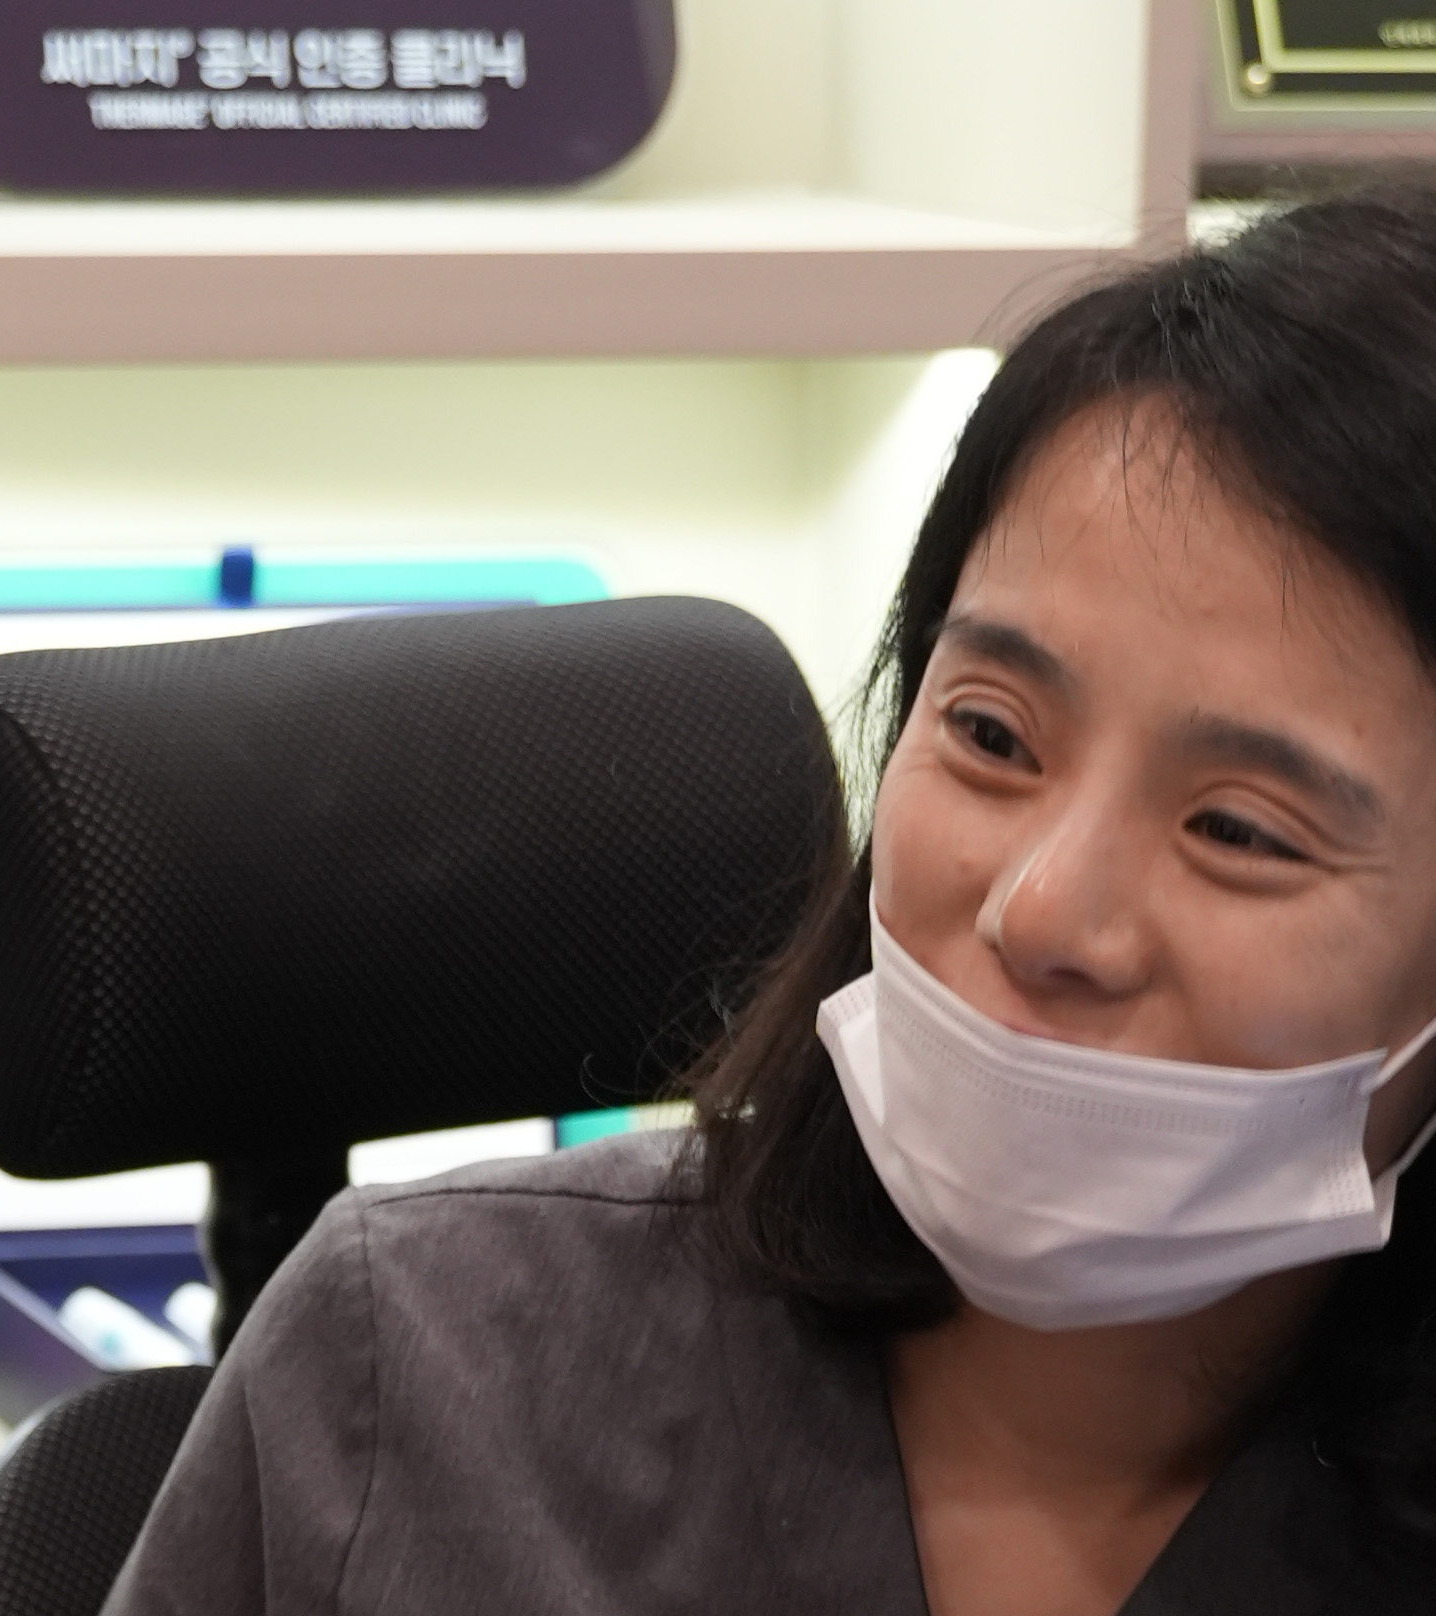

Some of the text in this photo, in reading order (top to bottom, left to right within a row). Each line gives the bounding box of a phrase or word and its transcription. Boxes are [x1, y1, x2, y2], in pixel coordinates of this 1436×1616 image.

[197, 28, 291, 90] 공식
[294, 28, 388, 90] 인증
[391, 28, 527, 90] 클리닉
